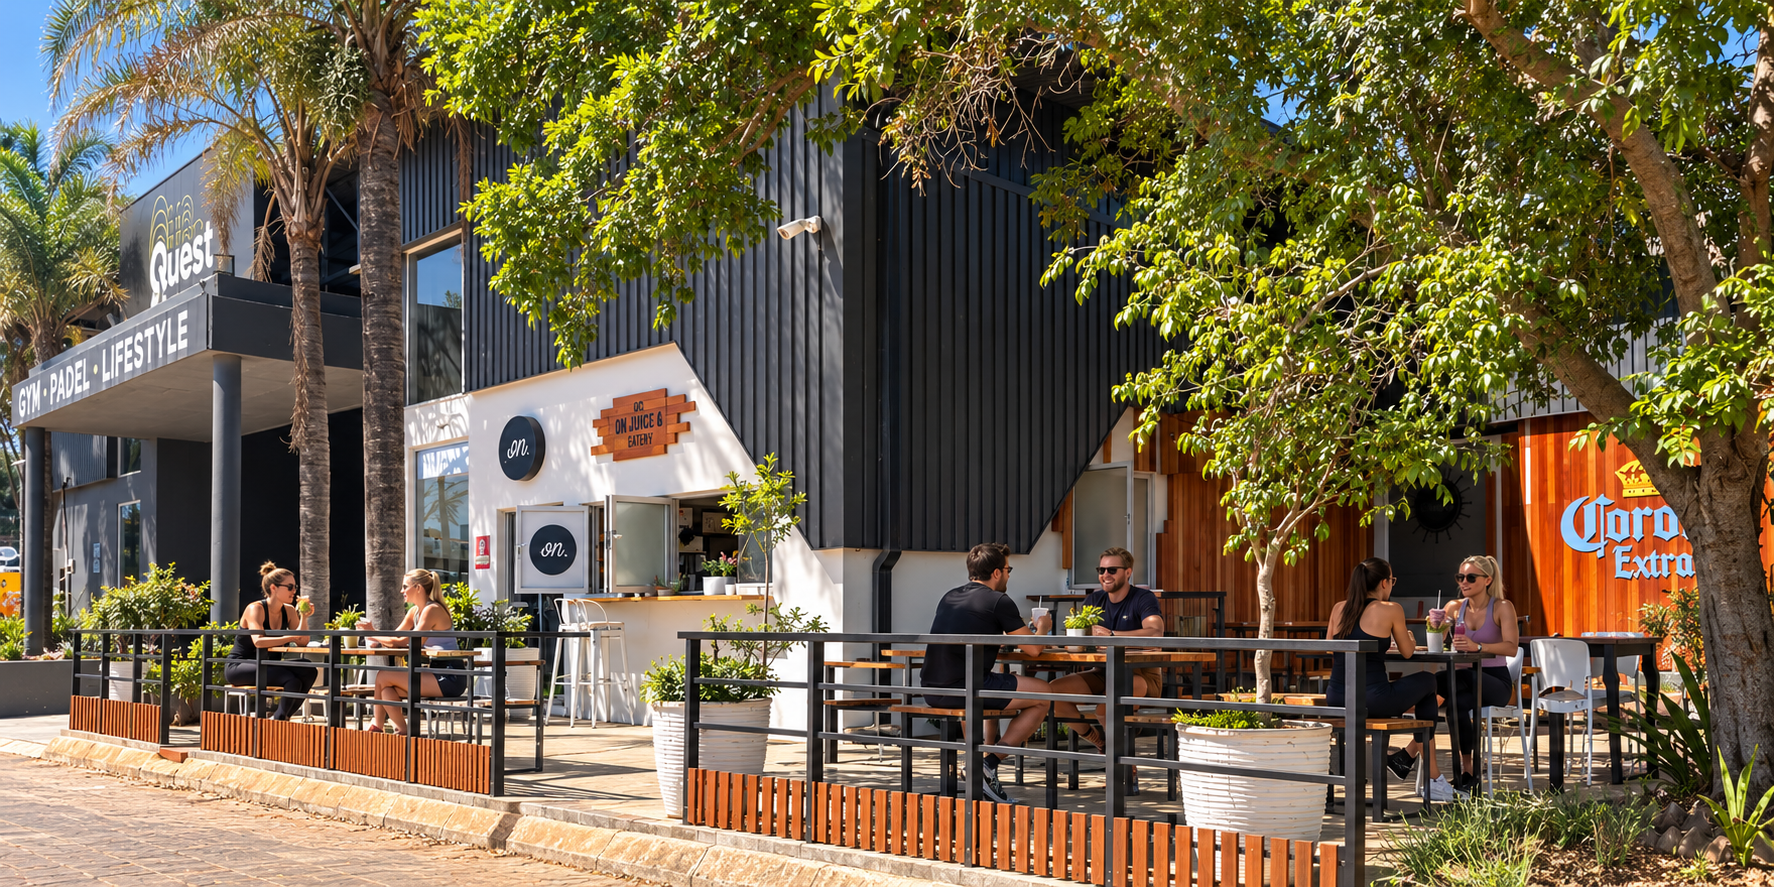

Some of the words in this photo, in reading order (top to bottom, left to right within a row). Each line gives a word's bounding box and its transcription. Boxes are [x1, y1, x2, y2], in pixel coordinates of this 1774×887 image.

[150, 221, 213, 295] Quest
[18, 379, 41, 418] GYM
[50, 358, 90, 405] PADEL
[102, 310, 189, 382] LIFESTYLE
[615, 417, 627, 435] ON
[629, 412, 655, 432] JUICE
[627, 432, 653, 448] EATERY
[1612, 545, 1695, 580] Extra
